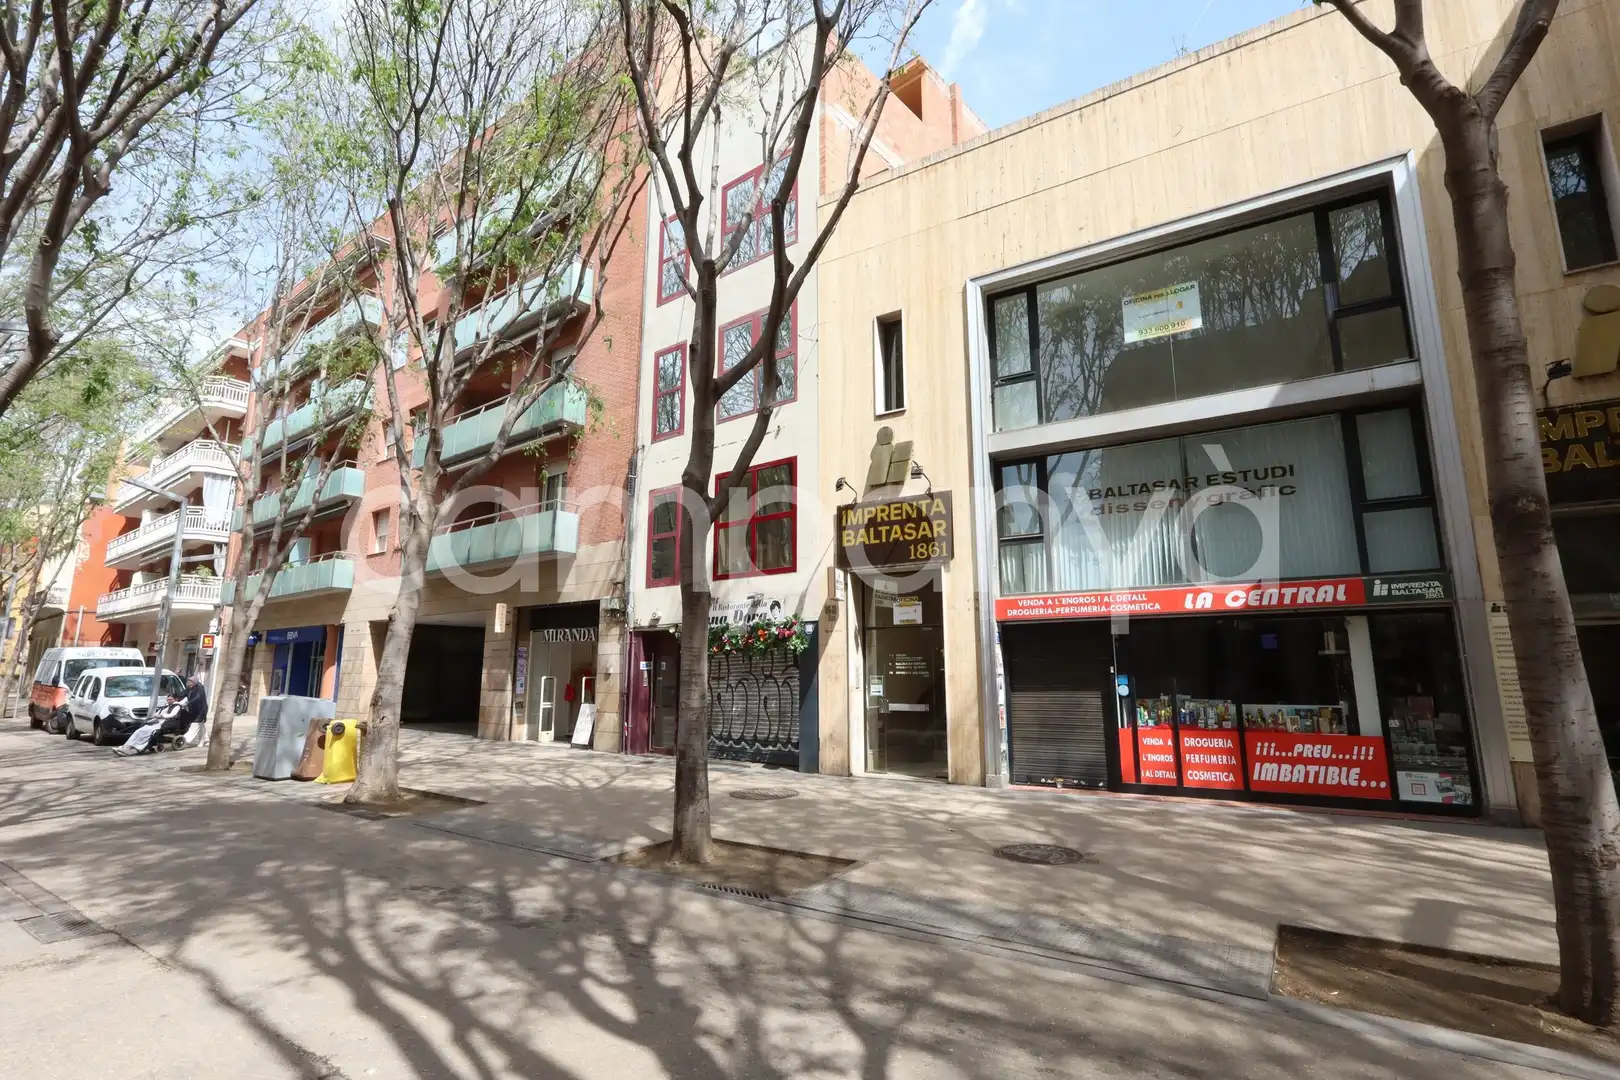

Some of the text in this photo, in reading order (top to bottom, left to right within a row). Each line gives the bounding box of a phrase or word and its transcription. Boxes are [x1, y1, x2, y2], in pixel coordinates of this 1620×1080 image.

[1123, 295, 1152, 305] OFICINA
[1138, 320, 1186, 336] 933 600 910
[1088, 464, 1295, 500] BALTASAR ESTUDI
[841, 498, 947, 527] IMPRENTA
[841, 519, 948, 547] BALTASAR
[909, 541, 949, 560] 1861
[1390, 581, 1442, 589] IMPRENTA
[1391, 587, 1443, 595] BALTASAR
[1017, 599, 1045, 607] VENDA
[1055, 596, 1096, 605] L'ENGROS
[1103, 596, 1114, 604] AL
[1116, 593, 1147, 602] DETALL
[1184, 584, 1346, 609] LA CENTRAL
[1007, 602, 1161, 617] DROGUERIA-PERFUMERIA-COSMETICA
[543, 628, 596, 643] MIRANDA
[1142, 737, 1173, 746] VENDA A
[1184, 737, 1234, 749] DROGUERIA
[1142, 753, 1173, 763] L'ENGROS
[1185, 753, 1237, 765] PERFUMERIA
[1145, 769, 1155, 778] AL
[1154, 770, 1177, 779] DETALL
[1187, 769, 1236, 782] COSMETICA
[1253, 761, 1387, 789] IMBATIBLE...
